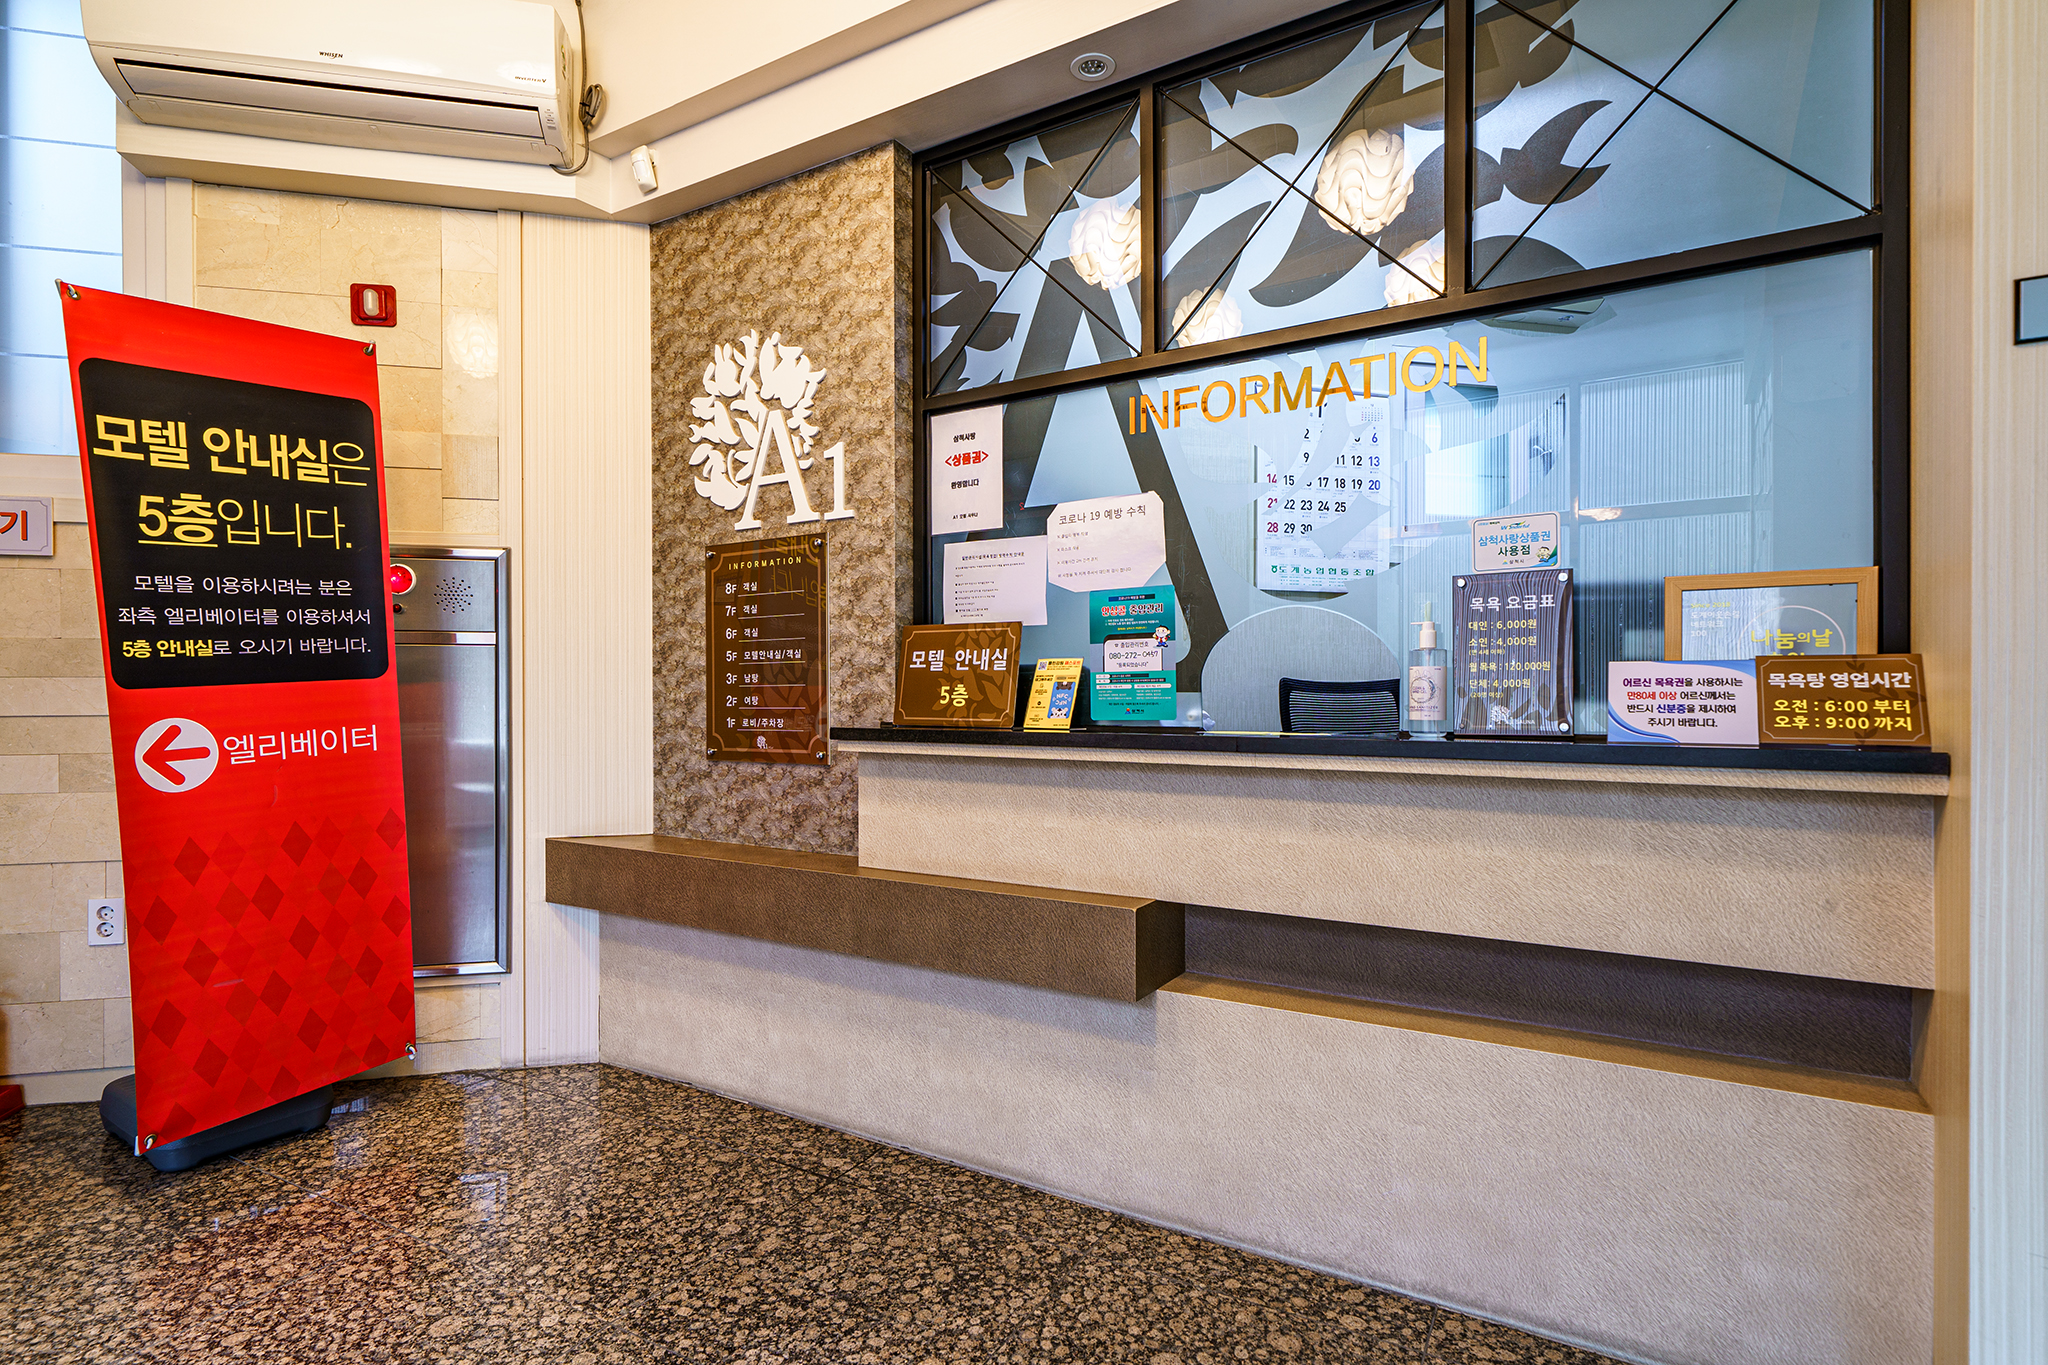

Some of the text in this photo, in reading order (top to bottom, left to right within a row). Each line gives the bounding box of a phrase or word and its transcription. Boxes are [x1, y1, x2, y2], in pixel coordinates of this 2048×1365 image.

[319, 51, 344, 59] WHISEN
[1129, 336, 1488, 435] INFORMATION
[1304, 428, 1378, 443] 2 6
[93, 415, 370, 486] 모텔 안내실은
[944, 450, 989, 467] <상품권>
[1304, 452, 1310, 463] 9
[1350, 456, 1362, 466] 12
[1368, 456, 1380, 467] 13
[735, 409, 854, 530] A1
[1266, 473, 1381, 491] 14 15 17 18 19 20
[1284, 500, 1296, 510] 22
[1300, 500, 1312, 510] 23
[1318, 501, 1330, 512] 24
[1334, 502, 1346, 512] 25
[138, 493, 352, 550] 5층입니다.
[1059, 505, 1146, 525] 코로나 19 예방 수칙
[1267, 522, 1312, 534] 28 29 30
[1478, 530, 1551, 547] 삼척사랑상품권
[1498, 544, 1530, 556] 사용점
[728, 556, 802, 570] INFORMATION
[134, 575, 352, 596] 모텔을 이용하시려는 분은
[725, 582, 758, 594] 8F 객실
[725, 604, 758, 616] 7F 객실
[1470, 594, 1556, 612] 목욕 요금표
[118, 608, 370, 626] 좌측 엘리베이터를 이용하셔서
[1468, 620, 1487, 631] 대인
[1496, 618, 1537, 630] 6,000원
[726, 628, 758, 640] 6F 객실
[122, 638, 372, 658] 5층 안내실로 오시기 바랍니다.
[1468, 638, 1487, 648] 소인
[1496, 636, 1537, 647] 4,000원
[726, 649, 802, 662] 5F 모텔안내실/객실
[910, 648, 1008, 672] 모텔 안내실
[1504, 661, 1551, 672] 120,000원
[726, 673, 758, 684] 3F 남탕
[1492, 678, 1531, 688] 4,000원
[1622, 678, 1743, 688] 어르신 목욕권을 사용하시는
[1768, 672, 1912, 688] 목욕탕 영업시간
[726, 695, 758, 706] 2F 여탕
[940, 684, 968, 707] 5층
[1627, 692, 1736, 700] 만80세 이상 어르신께서는
[1626, 704, 1736, 714] 반드시 신분증을 제시하여
[1773, 700, 1808, 713] 오전
[1824, 700, 1868, 712] 6:00
[1873, 700, 1911, 714] 부터
[726, 717, 784, 728] 1F 로비/주차장
[1648, 718, 1718, 728] 주시기 바랍니다.
[1774, 716, 1810, 730] 오후
[1826, 716, 1870, 730] 9:00
[1874, 716, 1912, 731] 까지
[223, 724, 378, 764] 엘리베이터
